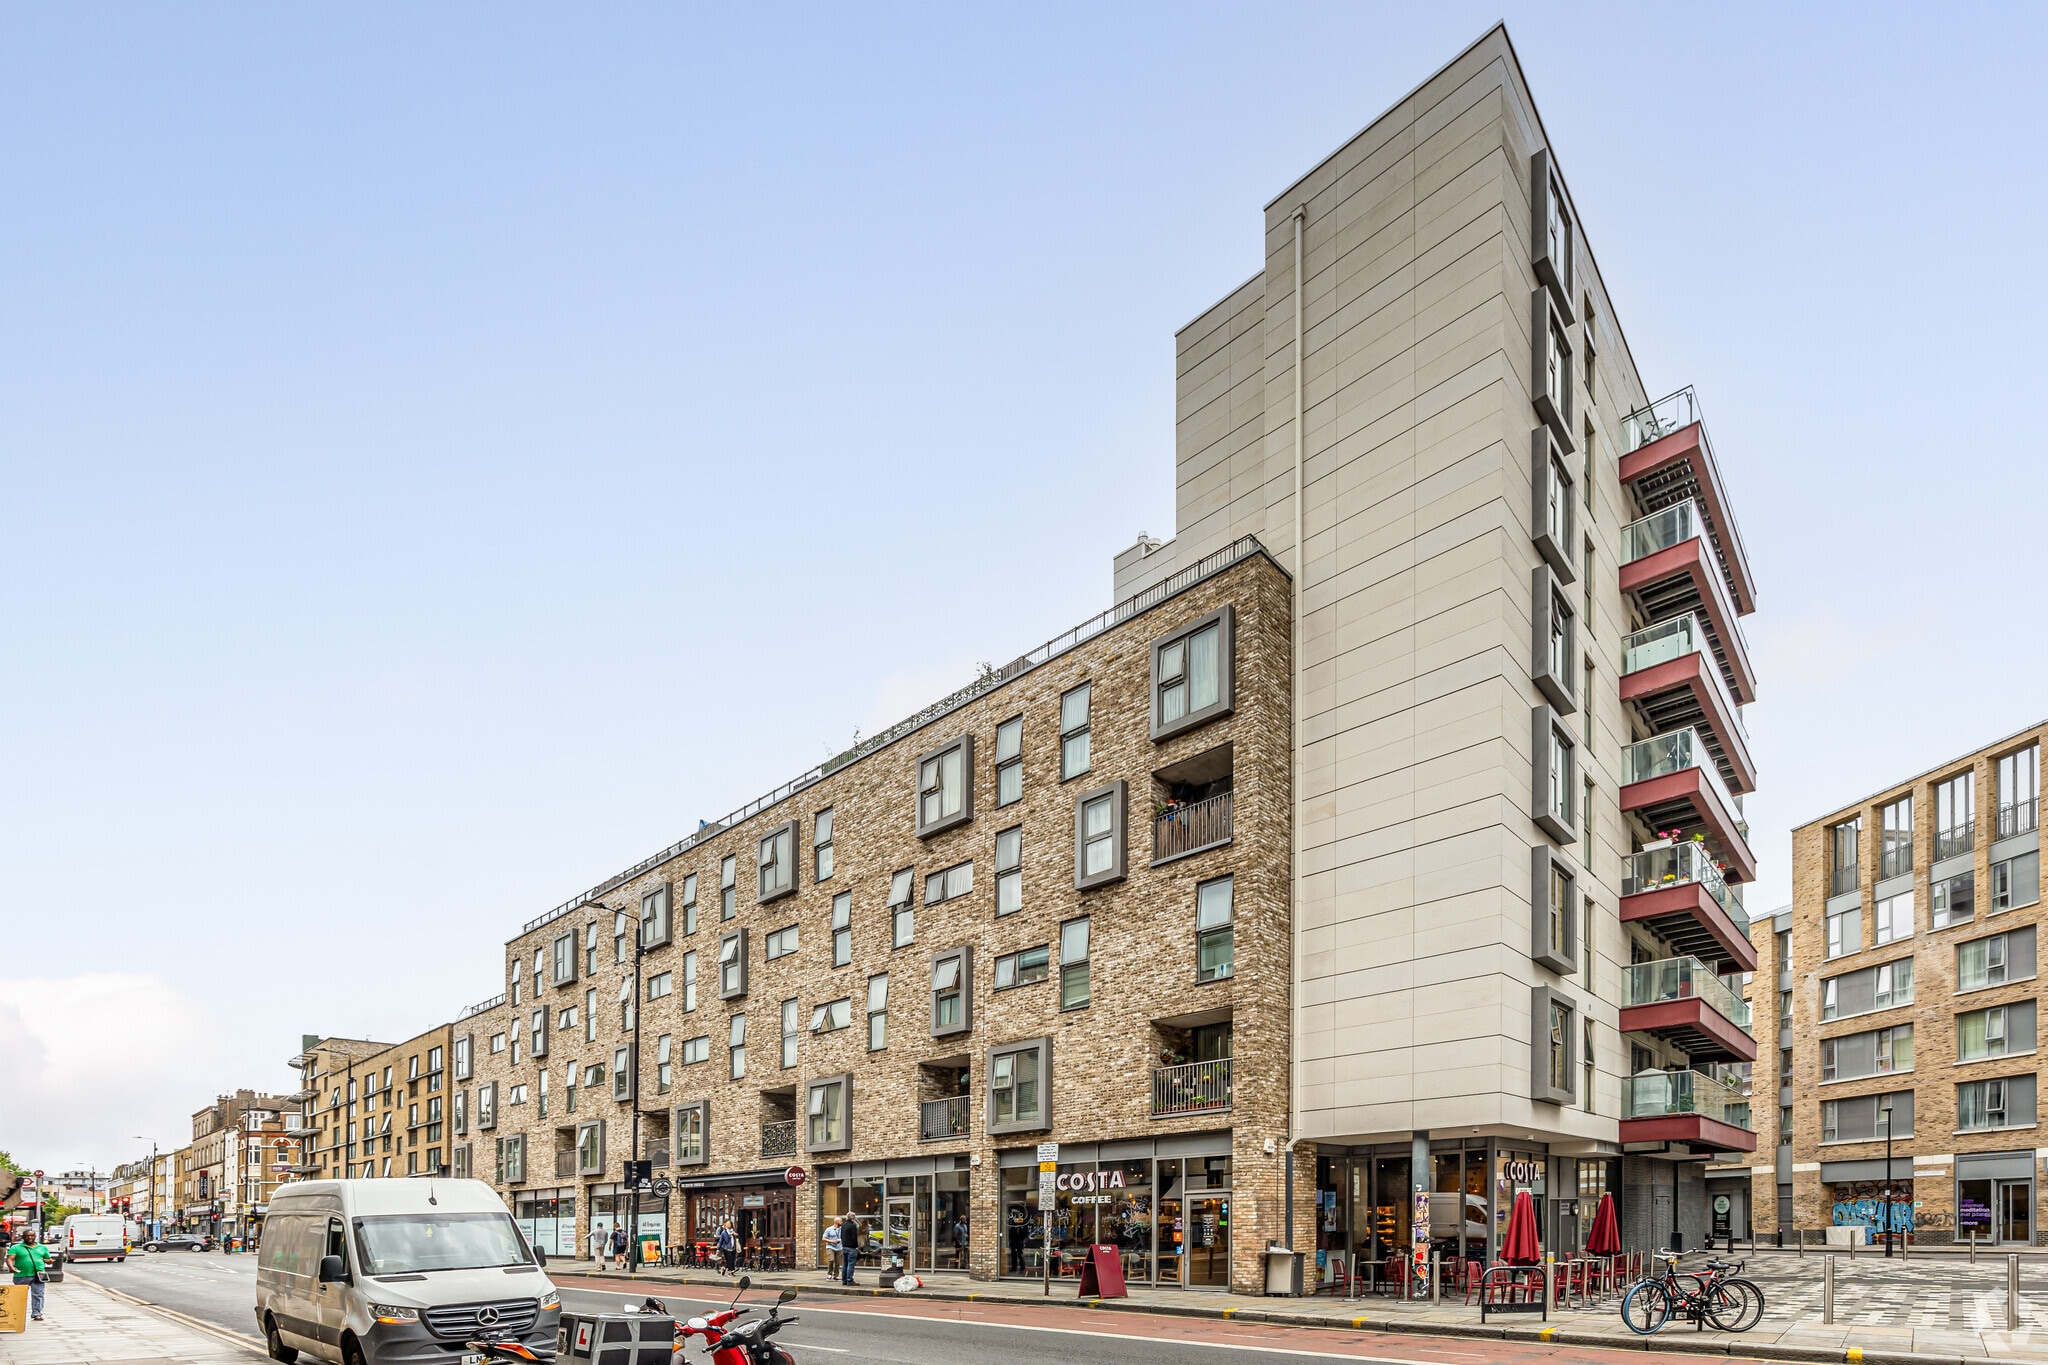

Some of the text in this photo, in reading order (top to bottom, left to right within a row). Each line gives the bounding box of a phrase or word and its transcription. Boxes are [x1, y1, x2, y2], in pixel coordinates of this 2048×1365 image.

[1057, 1170, 1125, 1192] COSTA
[1510, 1161, 1540, 1183] COSTA
[1071, 1195, 1111, 1204] COFFEE
[578, 1328, 587, 1345] L
